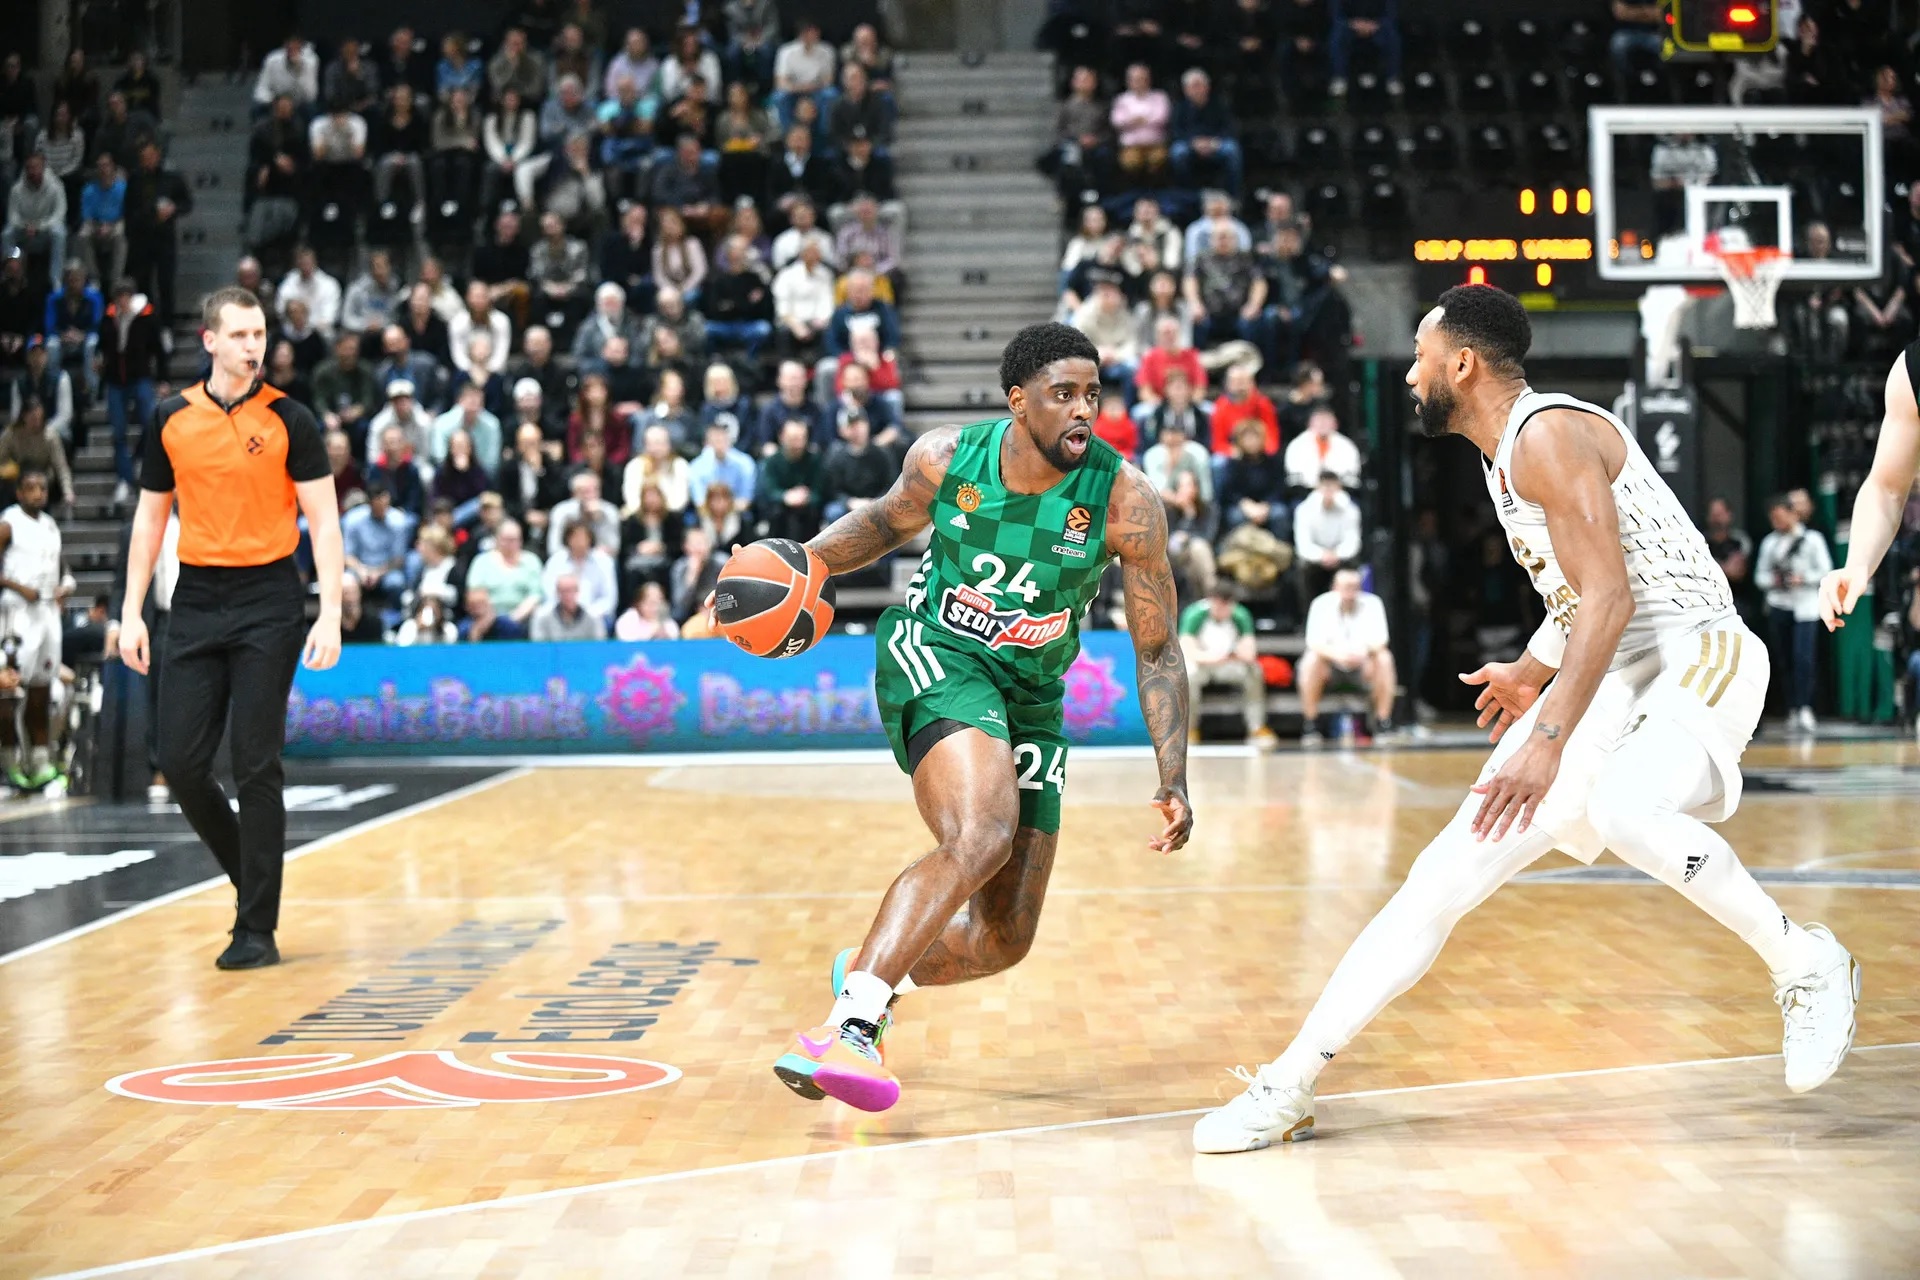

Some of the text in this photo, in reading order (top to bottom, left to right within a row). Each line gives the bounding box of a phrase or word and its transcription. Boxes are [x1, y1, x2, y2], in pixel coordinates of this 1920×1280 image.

[960, 590, 989, 610] pame
[972, 553, 1041, 604] 24
[700, 671, 881, 736] Deniz
[1012, 743, 1064, 795] 24
[1684, 854, 1709, 883] adidas
[257, 973, 491, 1046] TURKISH
[459, 941, 759, 1044] EuroLeague
